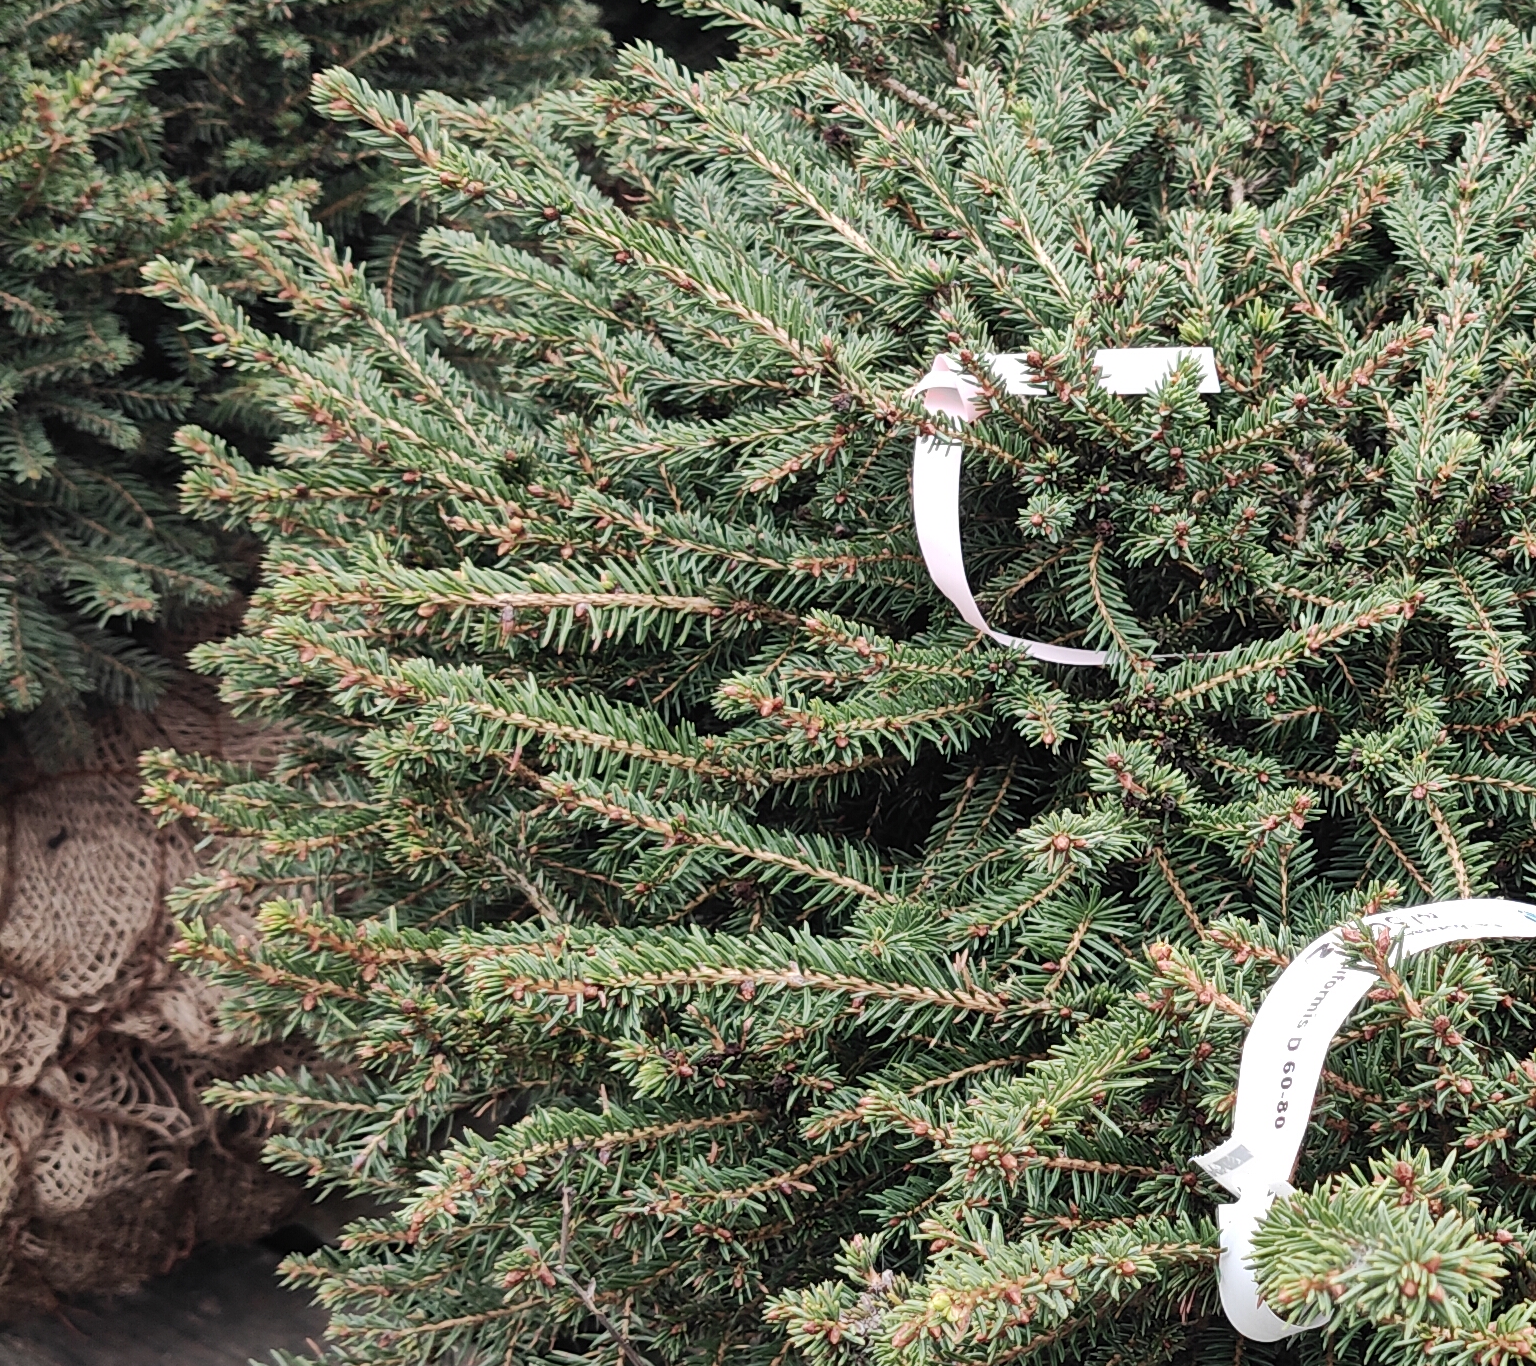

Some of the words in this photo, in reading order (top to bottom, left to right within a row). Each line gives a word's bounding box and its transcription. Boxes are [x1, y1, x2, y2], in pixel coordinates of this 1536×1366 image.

[1297, 961, 1349, 1029] iformis
[1287, 1037, 1302, 1051] D
[1274, 1061, 1296, 1129] 60-80
